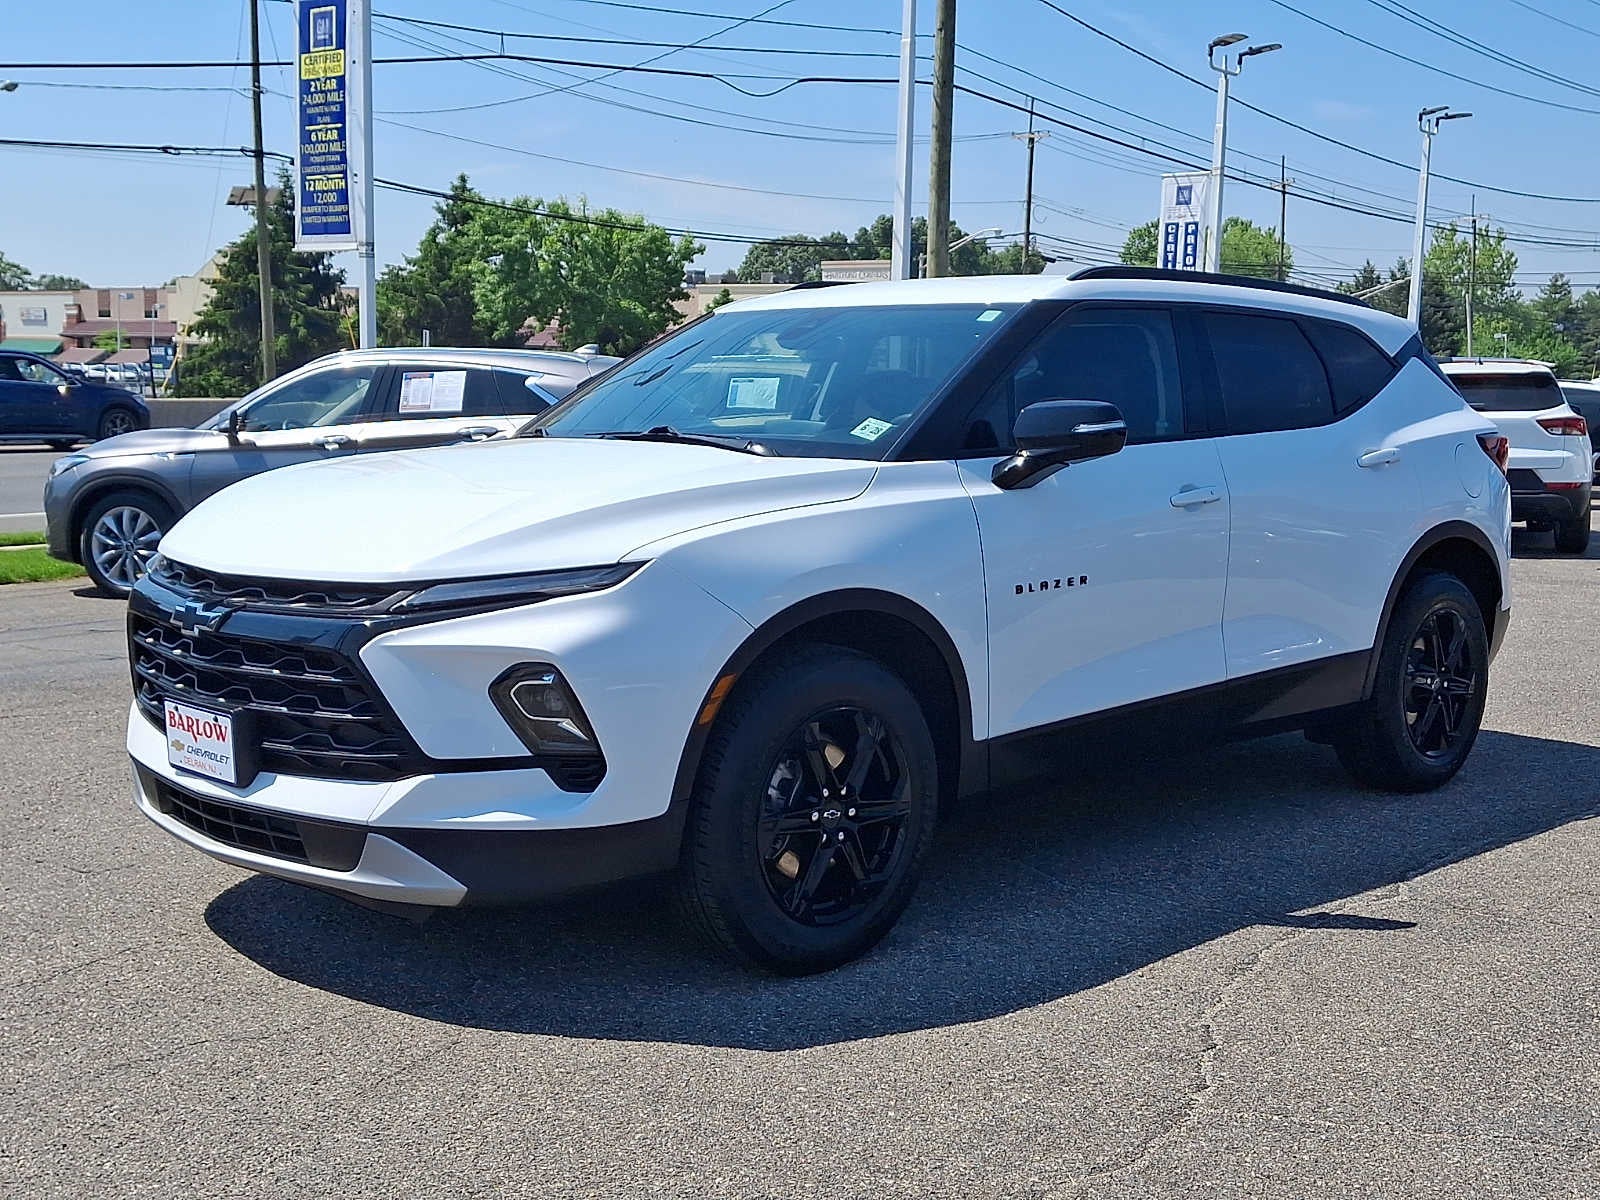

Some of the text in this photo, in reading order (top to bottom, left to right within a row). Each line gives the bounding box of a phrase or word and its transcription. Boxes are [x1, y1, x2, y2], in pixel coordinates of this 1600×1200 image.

[304, 52, 342, 66] CERTIFIED
[310, 78, 337, 92] 2 YEAR
[303, 90, 344, 105] 24,000 MILE
[310, 130, 338, 142] 6 YEAR
[300, 141, 346, 154] 100,000 MILE
[305, 179, 346, 192] 12 MONTH
[313, 192, 337, 204] 12,000
[1015, 575, 1088, 595] BLAZER
[168, 710, 228, 743] BARLOW
[187, 745, 231, 765] CHEVROLET
